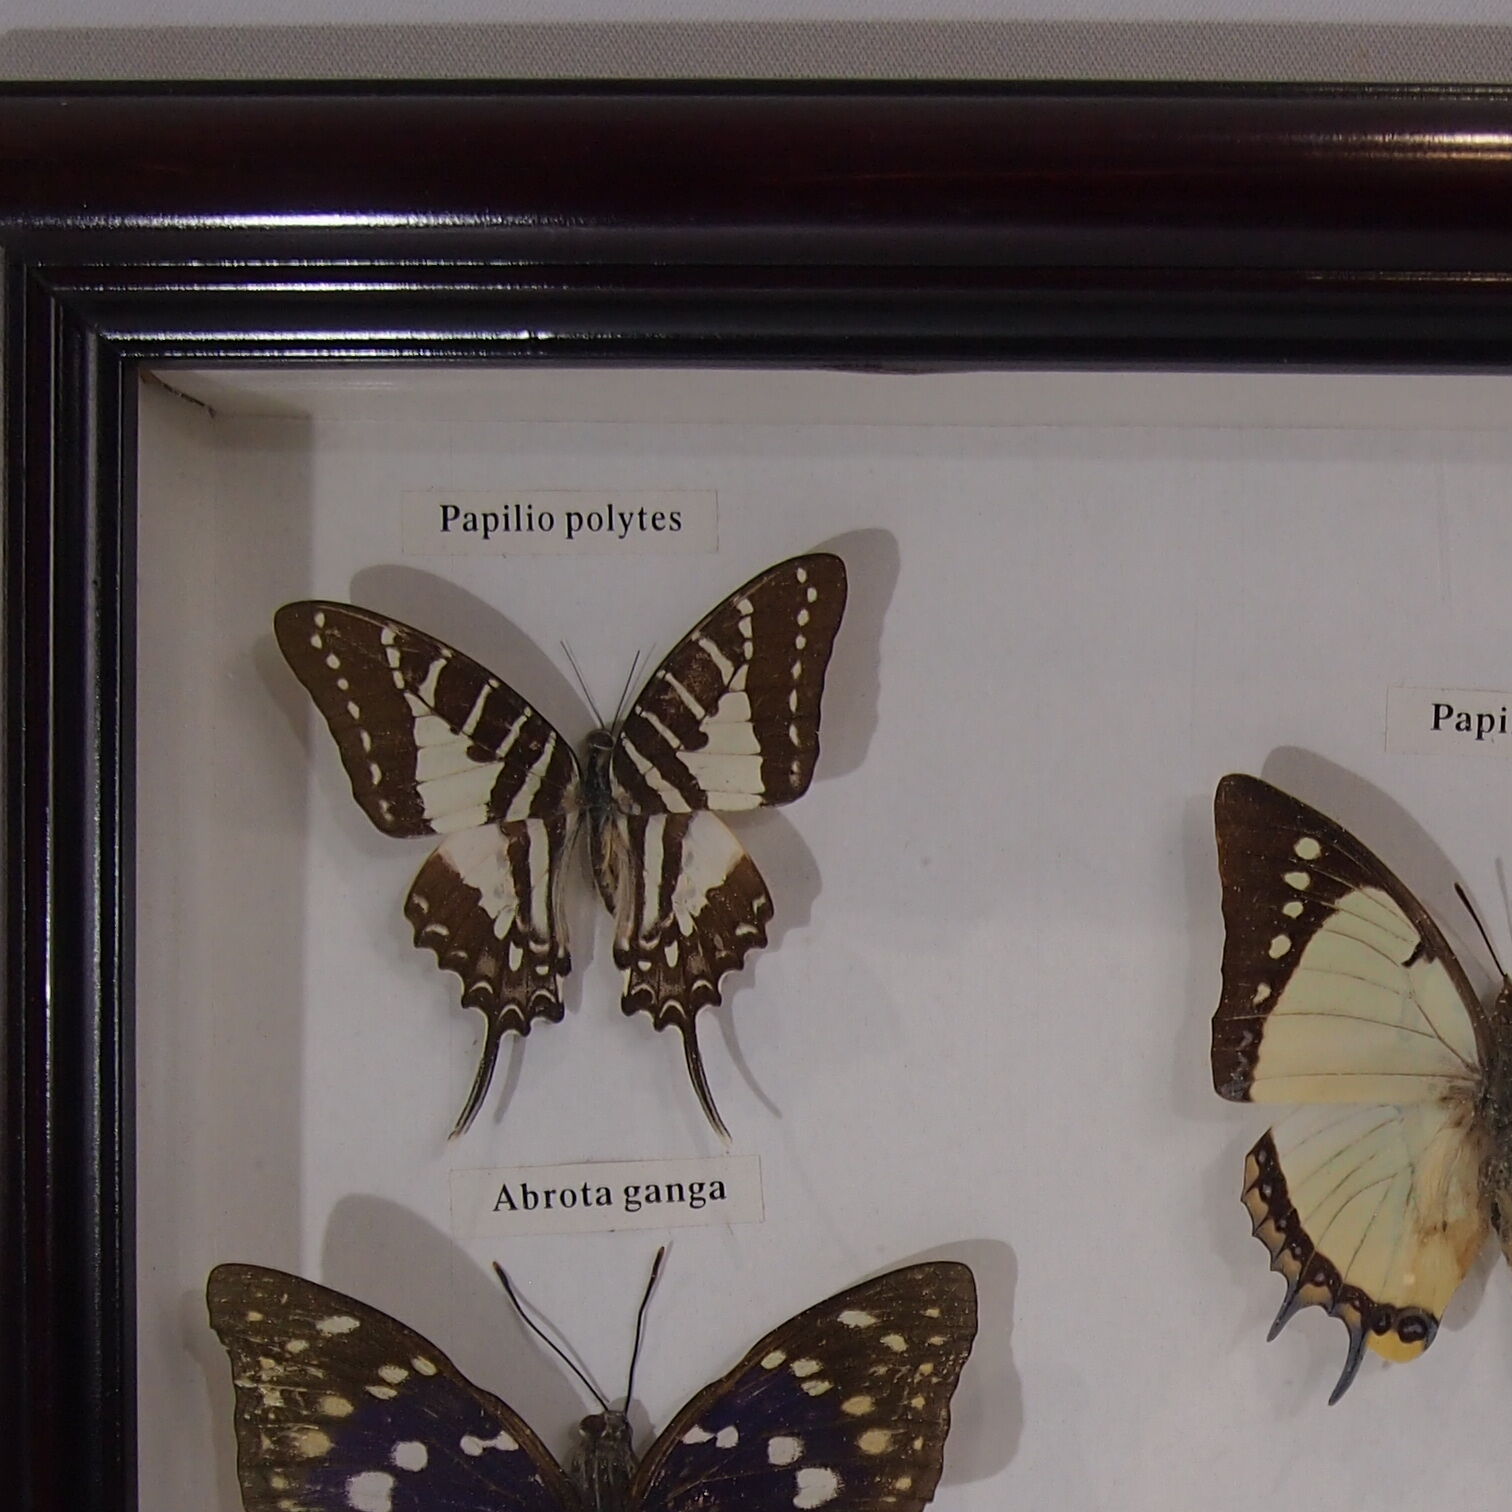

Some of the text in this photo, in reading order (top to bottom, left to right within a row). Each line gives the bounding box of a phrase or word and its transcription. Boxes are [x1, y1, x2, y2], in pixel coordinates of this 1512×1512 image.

[439, 503, 682, 541] Papilio polytes
[492, 1180, 727, 1213] Abrota ganga
